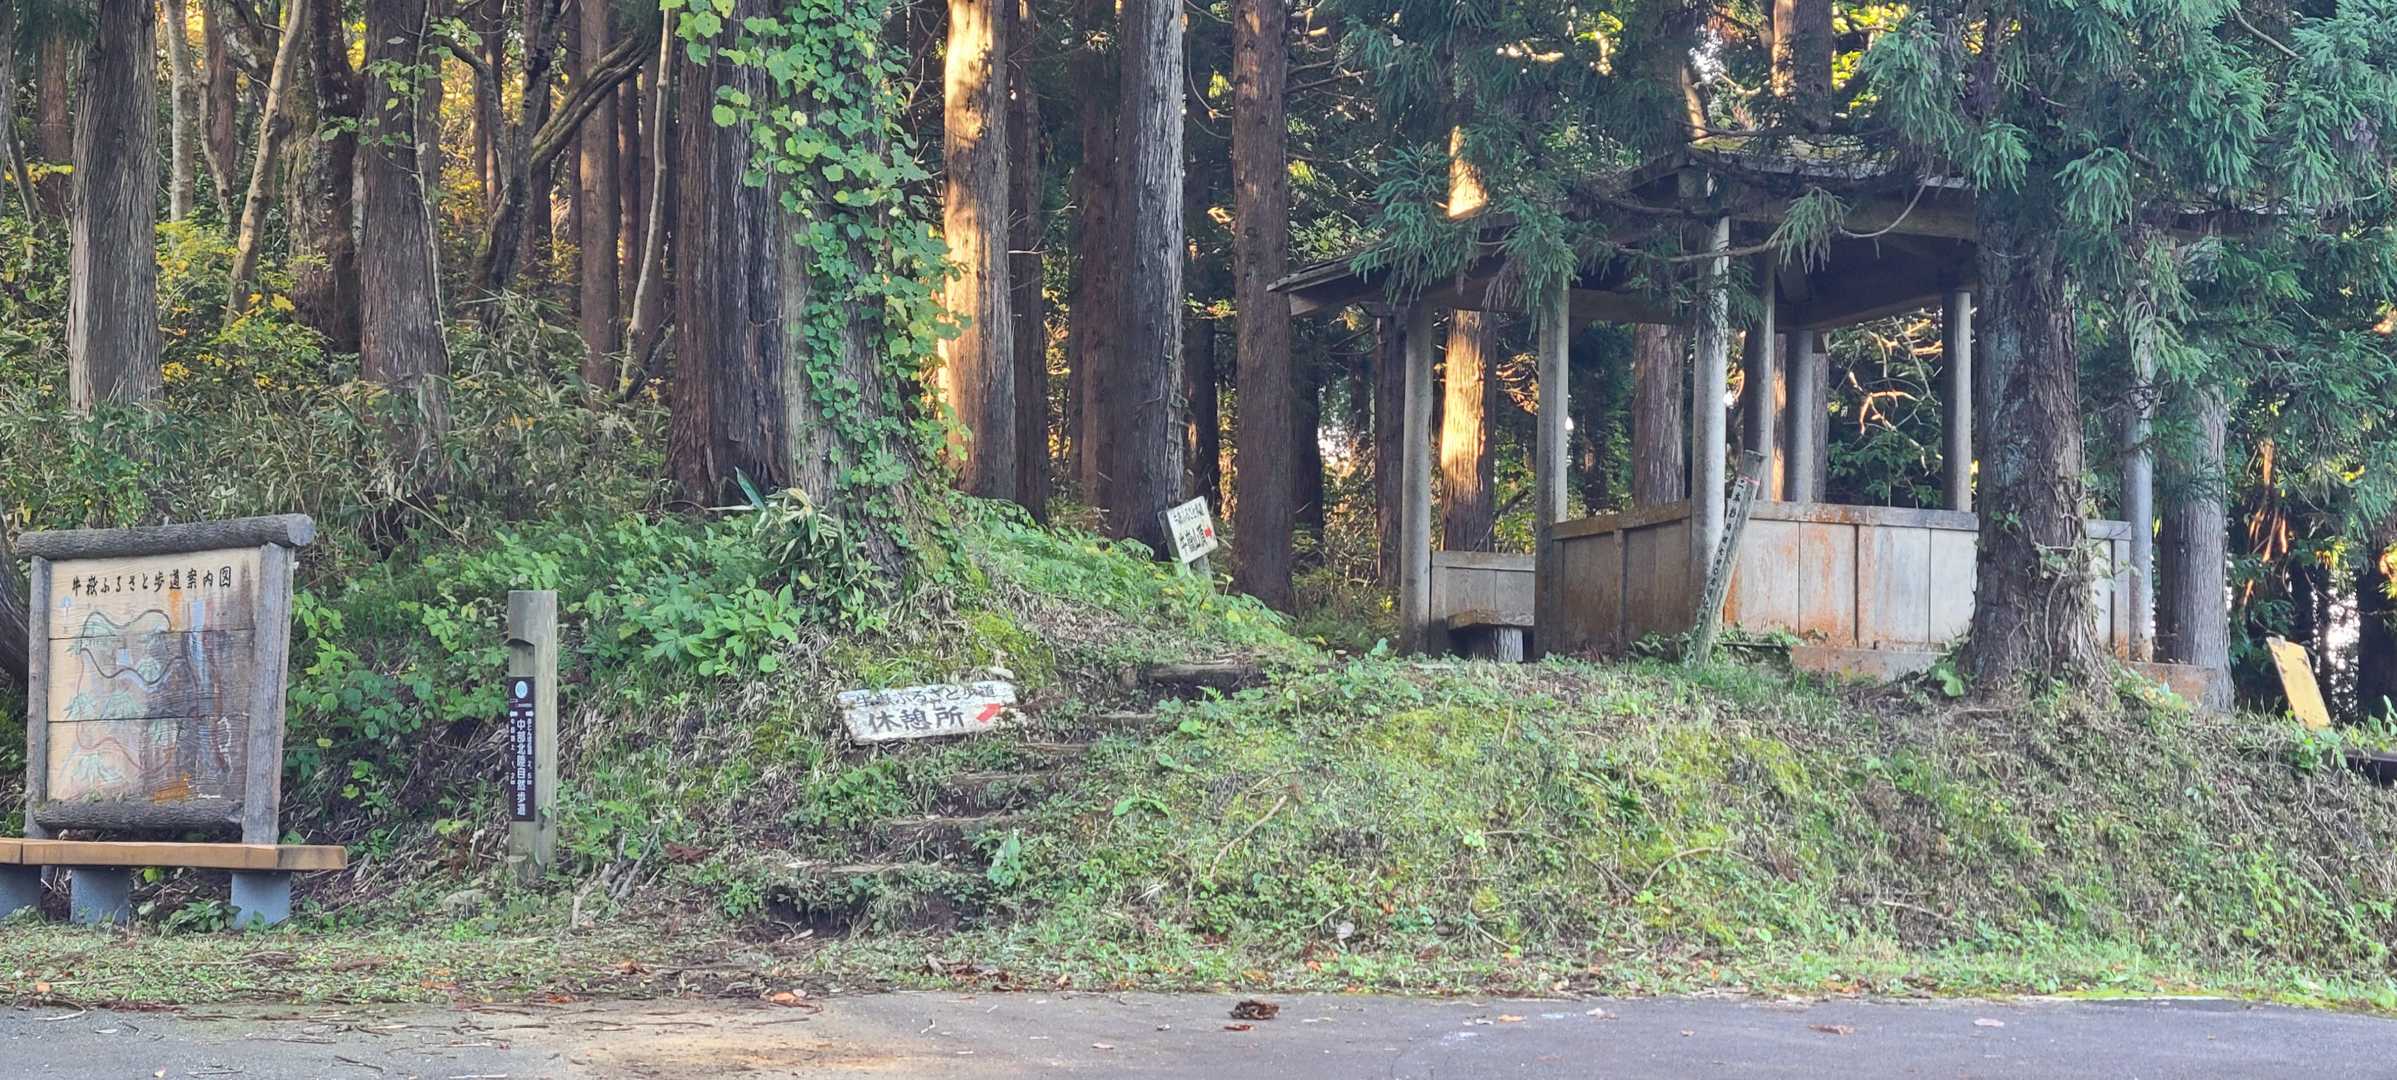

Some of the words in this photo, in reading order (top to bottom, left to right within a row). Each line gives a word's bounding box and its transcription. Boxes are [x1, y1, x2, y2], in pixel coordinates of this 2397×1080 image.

[868, 706, 965, 733] 休憩所
[516, 718, 526, 816] 中部北陸自然歩道
